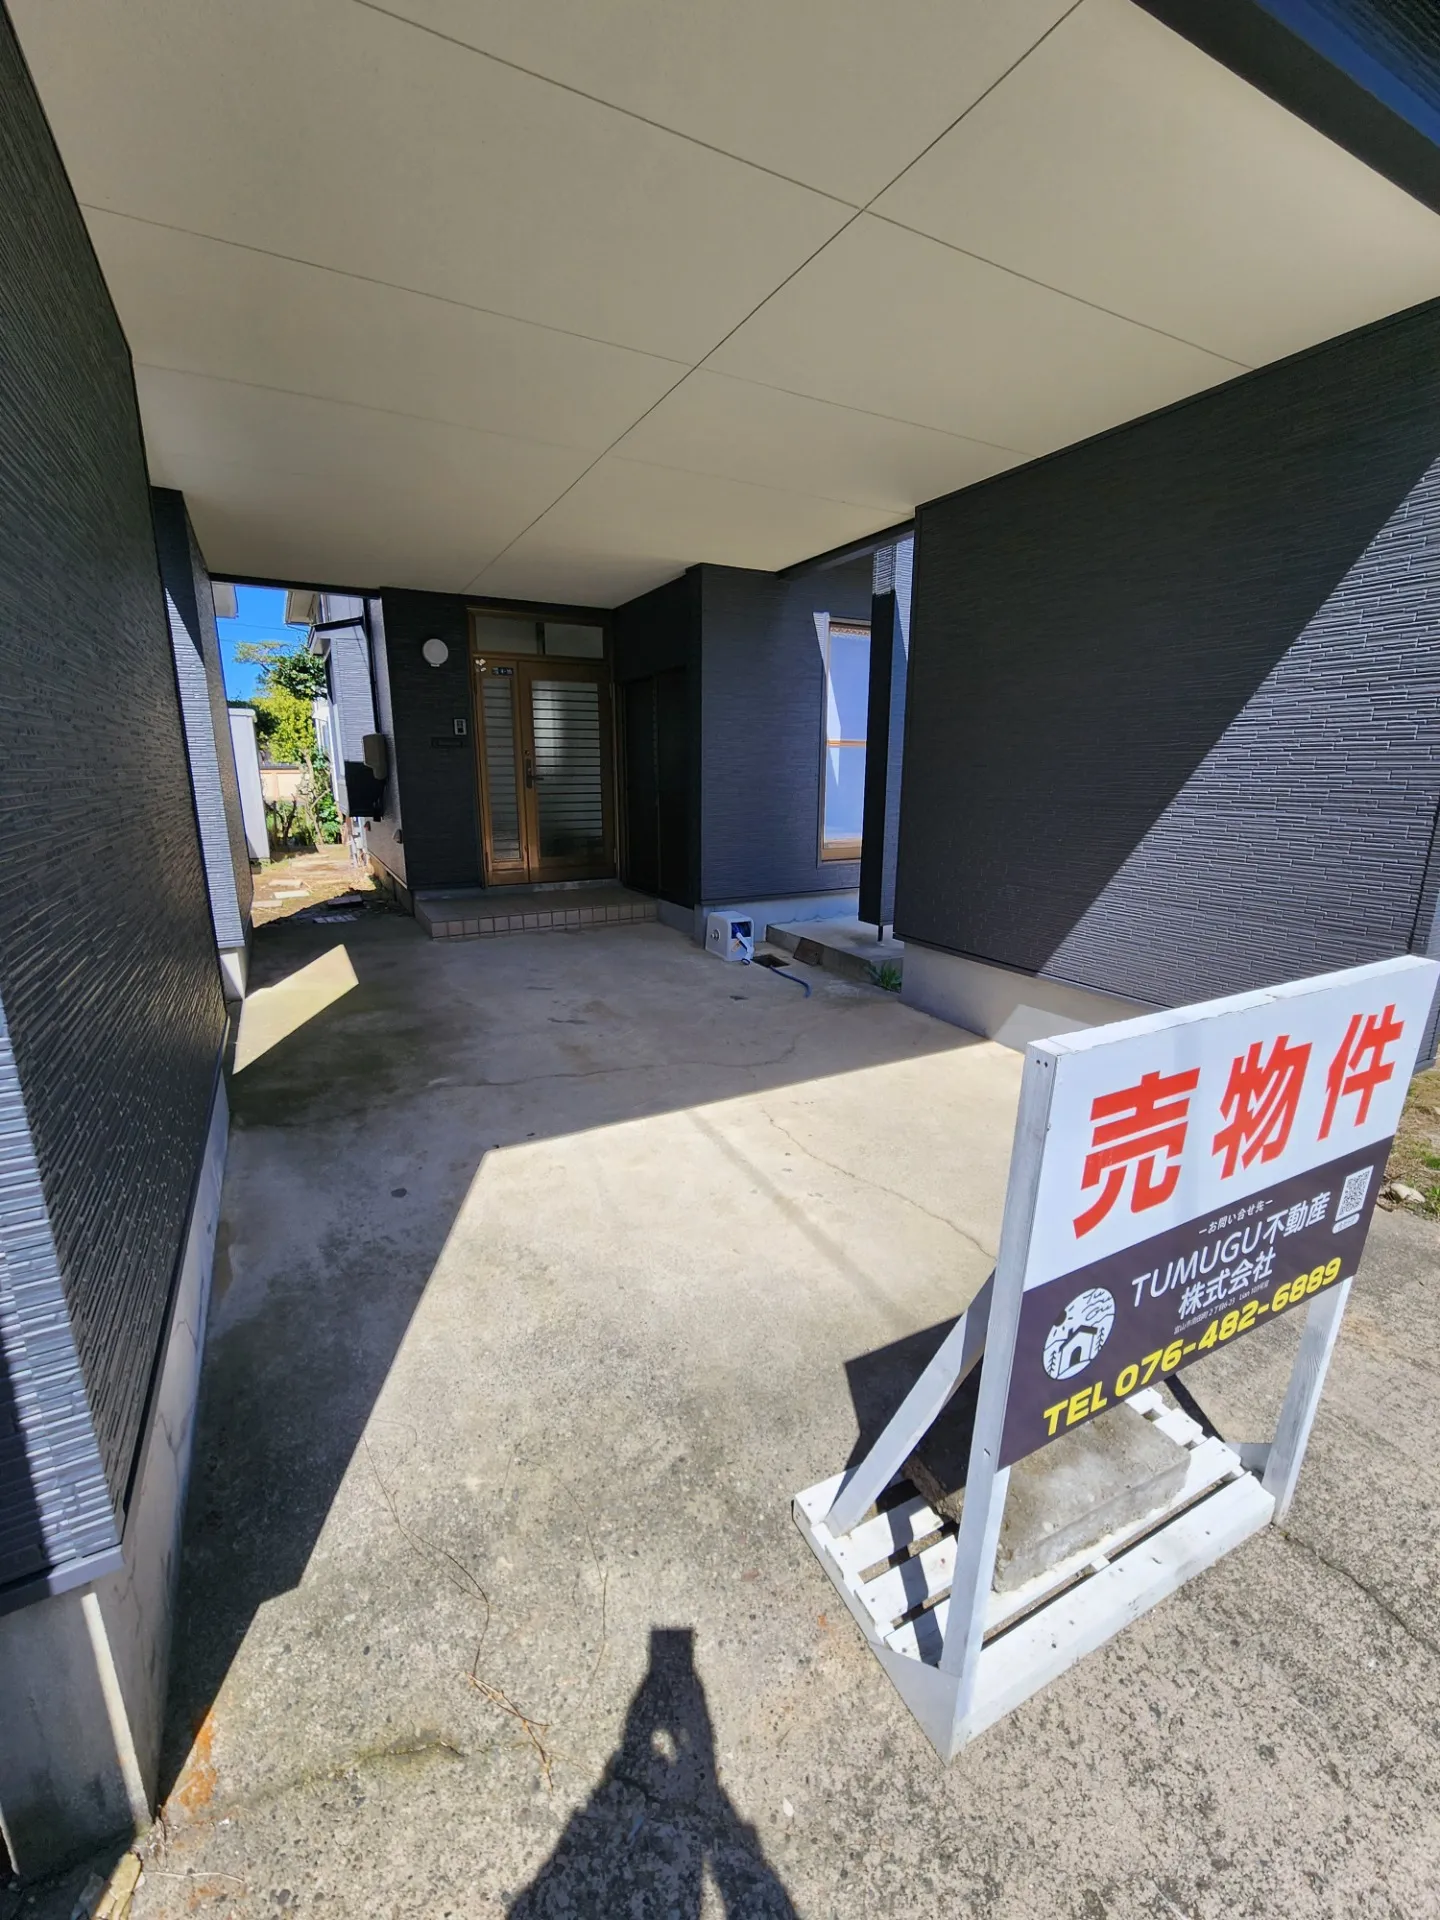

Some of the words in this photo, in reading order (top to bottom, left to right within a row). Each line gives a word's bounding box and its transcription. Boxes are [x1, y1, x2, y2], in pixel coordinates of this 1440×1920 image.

[1073, 1004, 1405, 1239] 売物件
[1043, 1381, 1108, 1436] TEL
[1115, 1257, 1342, 1398] 076-482-6889
[1178, 1247, 1276, 1320] 株式会社
